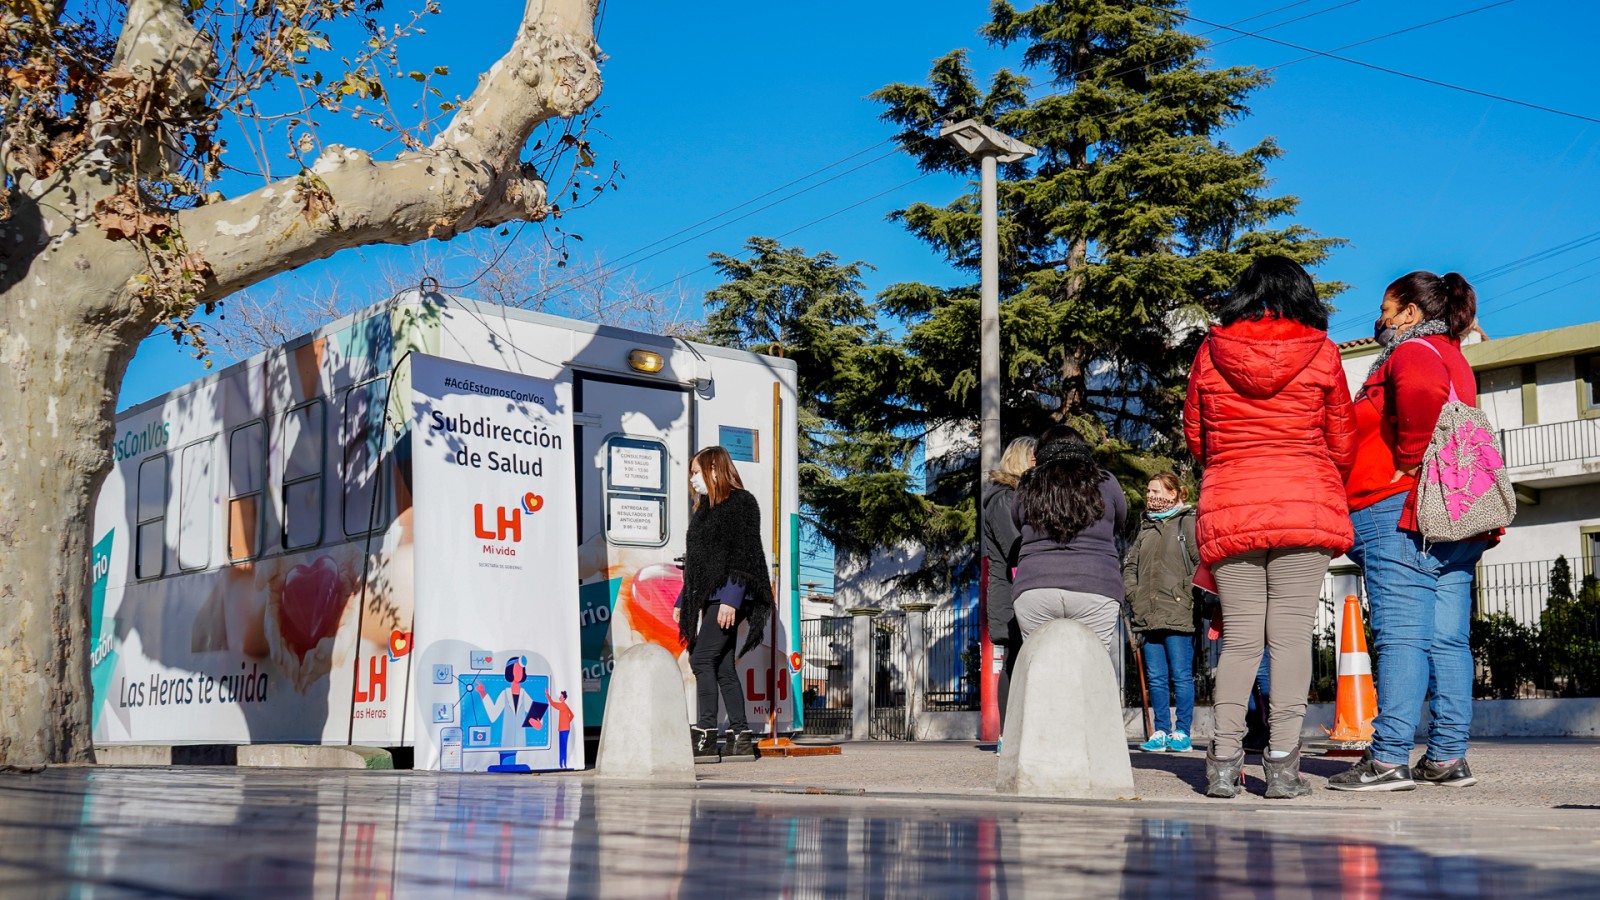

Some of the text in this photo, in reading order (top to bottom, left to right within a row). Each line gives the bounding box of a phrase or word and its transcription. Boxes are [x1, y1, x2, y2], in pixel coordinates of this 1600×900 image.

[444, 377, 545, 405] #AcáEstamosConVos
[431, 410, 562, 450] Subdirección
[456, 445, 543, 477] de Salud
[474, 503, 522, 543] LH
[482, 544, 516, 556] Mi vida
[119, 661, 269, 708] Las Heras te cuida
[354, 655, 387, 703] LH
[365, 707, 387, 719] Heras
[753, 706, 782, 715] Mi va
